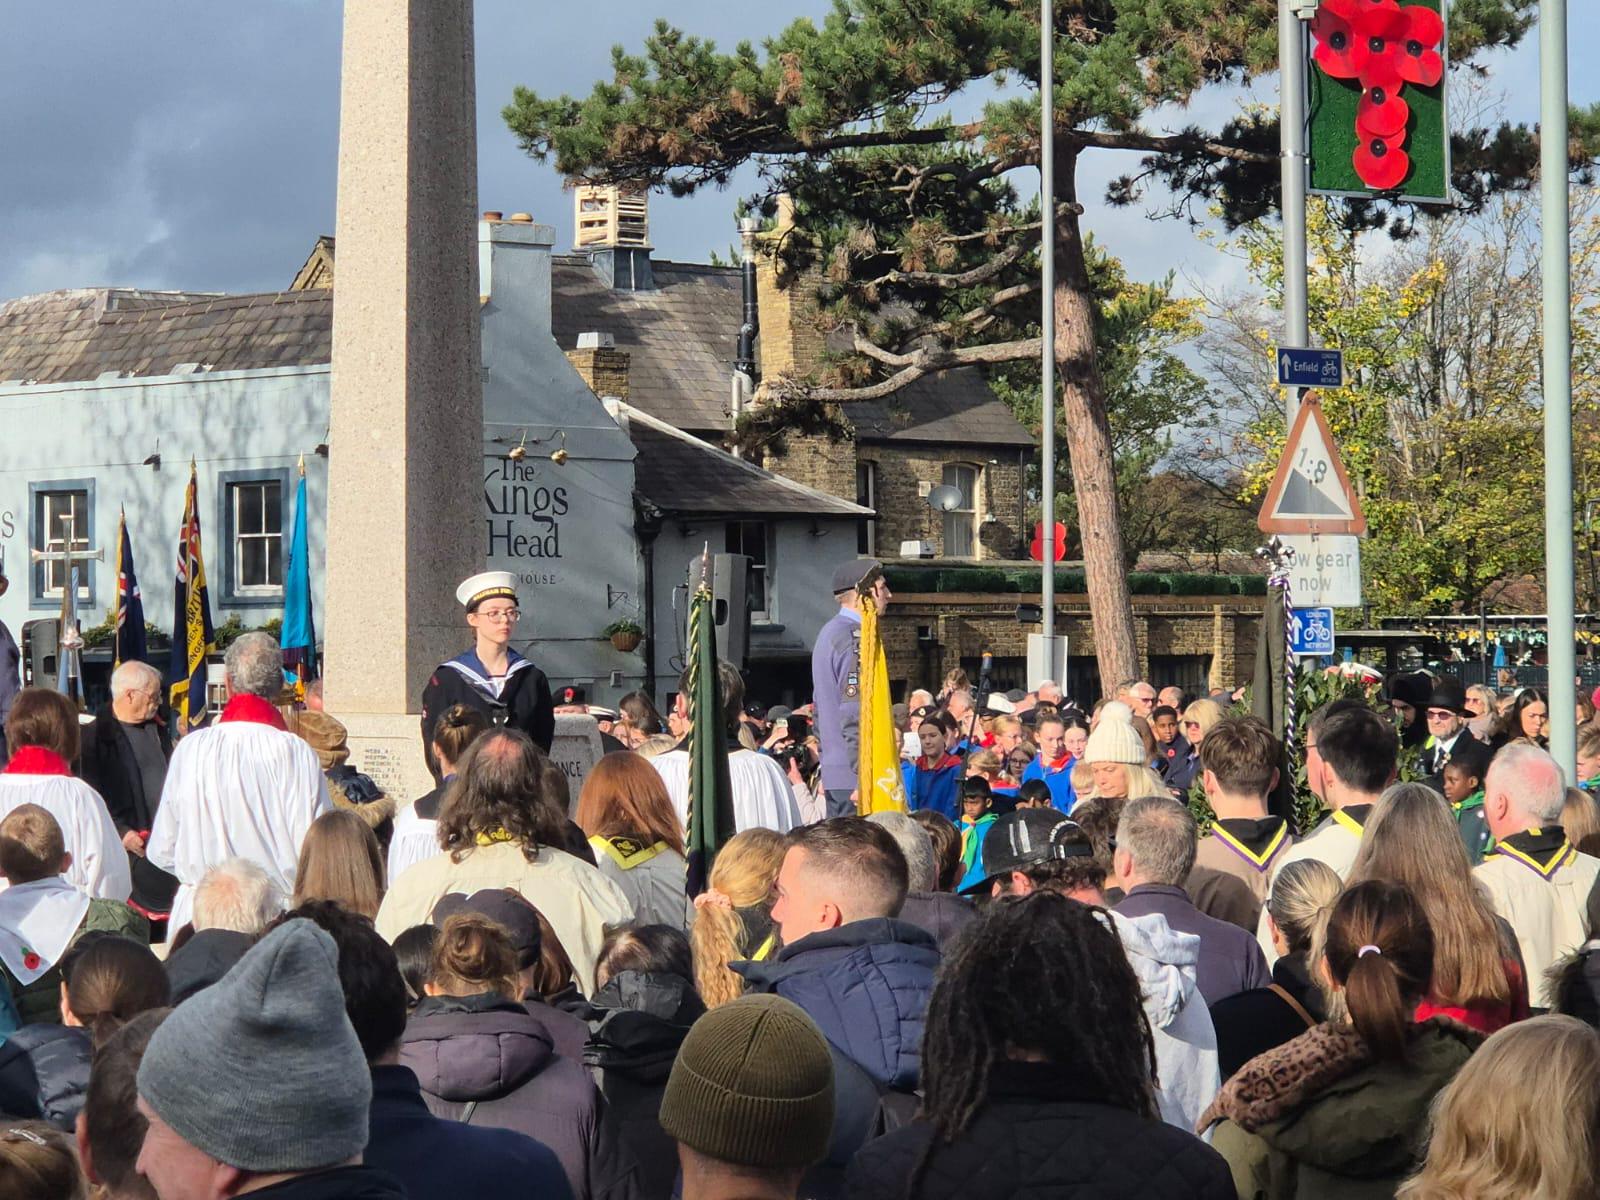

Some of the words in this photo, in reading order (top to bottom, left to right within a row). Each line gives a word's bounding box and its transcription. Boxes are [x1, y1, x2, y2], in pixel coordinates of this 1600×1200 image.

[1294, 360, 1318, 372] Enfield
[498, 457, 534, 481] The
[486, 519, 562, 558] Head
[1285, 553, 1310, 567] ow
[1316, 553, 1352, 571] gear
[1300, 577, 1331, 591] now
